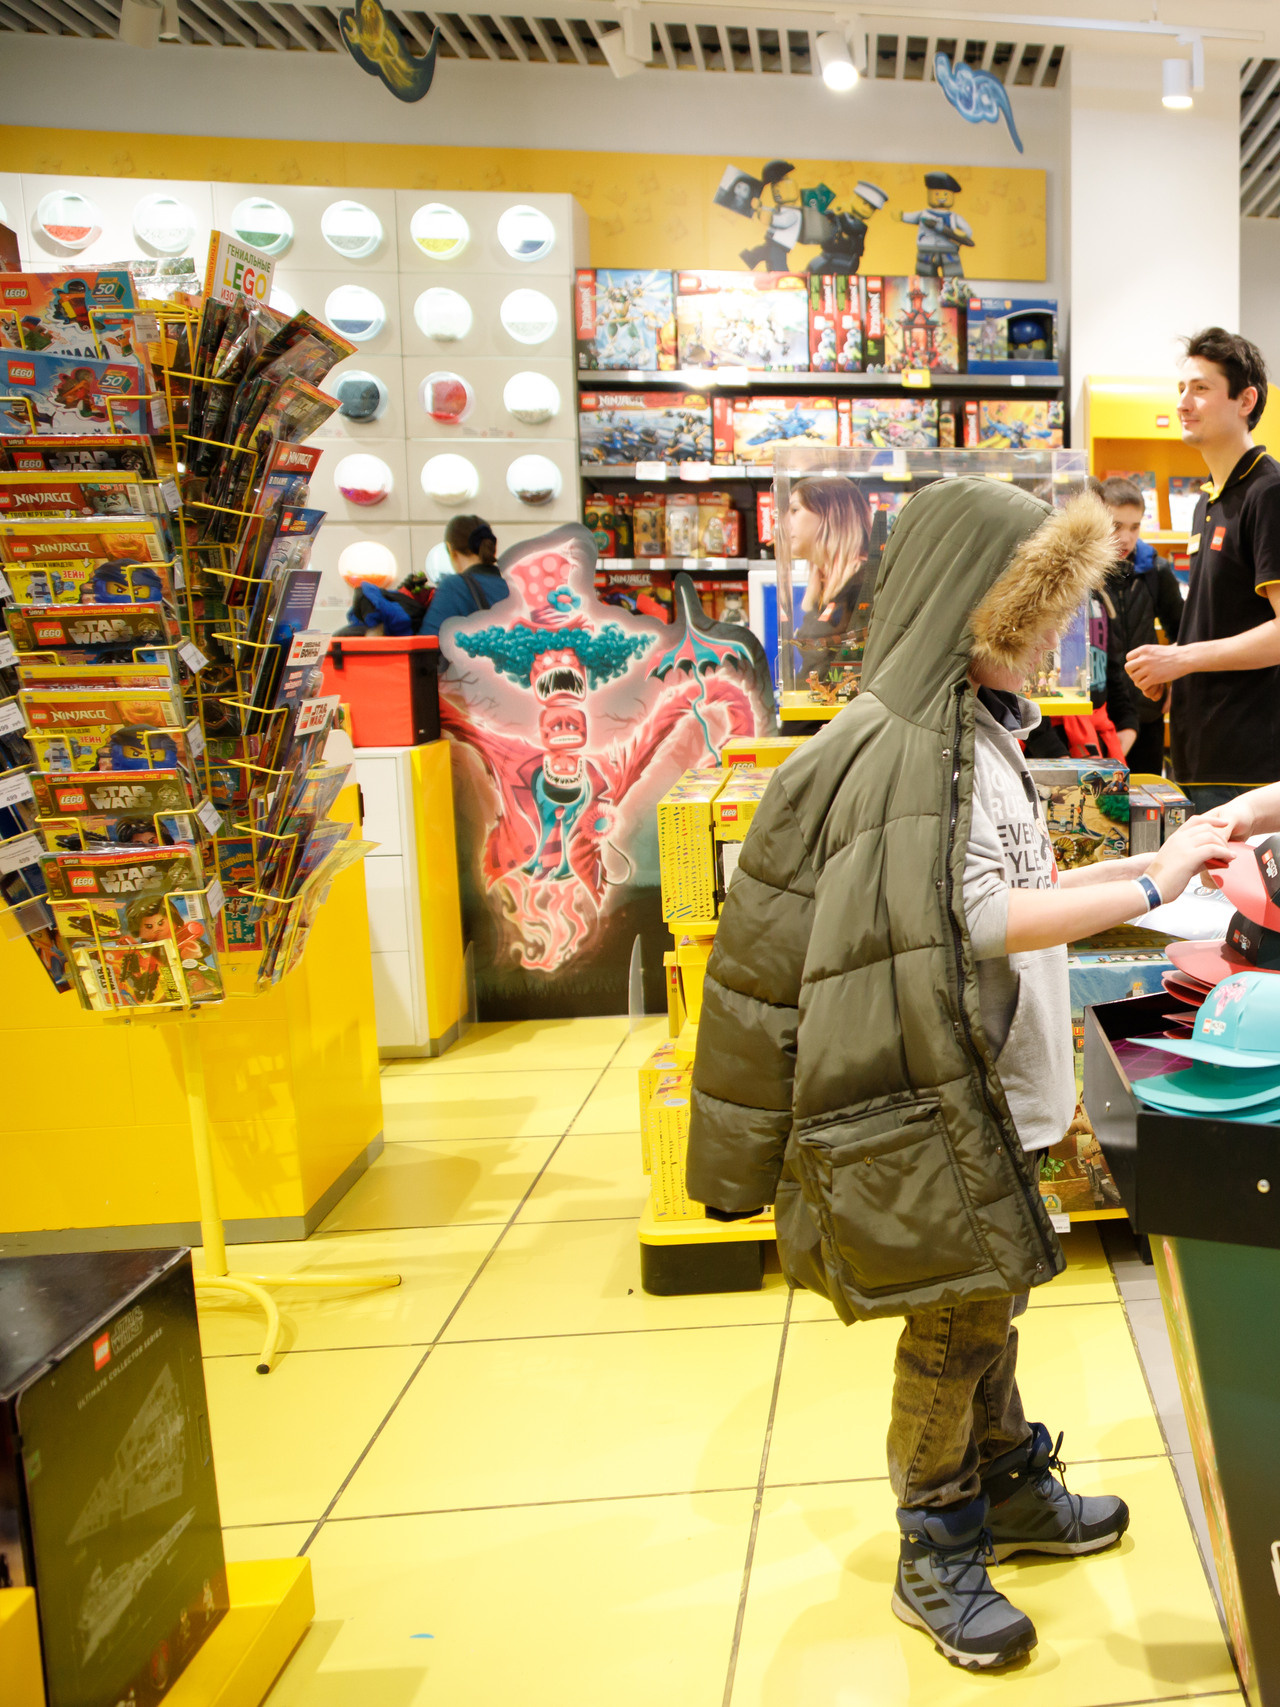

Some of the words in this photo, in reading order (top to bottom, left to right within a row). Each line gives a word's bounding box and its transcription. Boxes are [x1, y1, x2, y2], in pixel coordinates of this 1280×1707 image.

[227, 244, 271, 273] ГЕНИАЛЬНЫЕ
[223, 258, 267, 300] LEGO
[5, 288, 27, 298] LEGO
[95, 283, 115, 295] 50
[10, 368, 33, 378] LEGO
[102, 376, 122, 387] 50
[598, 396, 646, 408] NINJAGO
[19, 459, 42, 469] LEGO
[57, 452, 109, 464] STAR
[285, 451, 314, 469] NINJAGO
[13, 492, 77, 507] NINJAGO
[32, 542, 95, 556] NINJAGO
[62, 570, 86, 579] ЗЕЙН
[609, 574, 653, 586] NINJAGO
[73, 619, 127, 632] STAR
[38, 628, 62, 638] LEGO
[68, 629, 134, 645] WARS
[51, 709, 112, 723] NINJAGO
[80, 736, 102, 744] ЗЕЙН
[7, 794, 18, 802] 499
[95, 786, 147, 798] STAR
[60, 794, 83, 805] LEGO
[90, 796, 153, 810] WARS
[722, 809, 736, 817] LEGO
[105, 866, 157, 879] STAR
[72, 877, 94, 887] LEGO
[100, 876, 164, 894] WARS
[108, 1345, 143, 1381] COLLECTOR
[144, 1327, 163, 1349] SERIES
